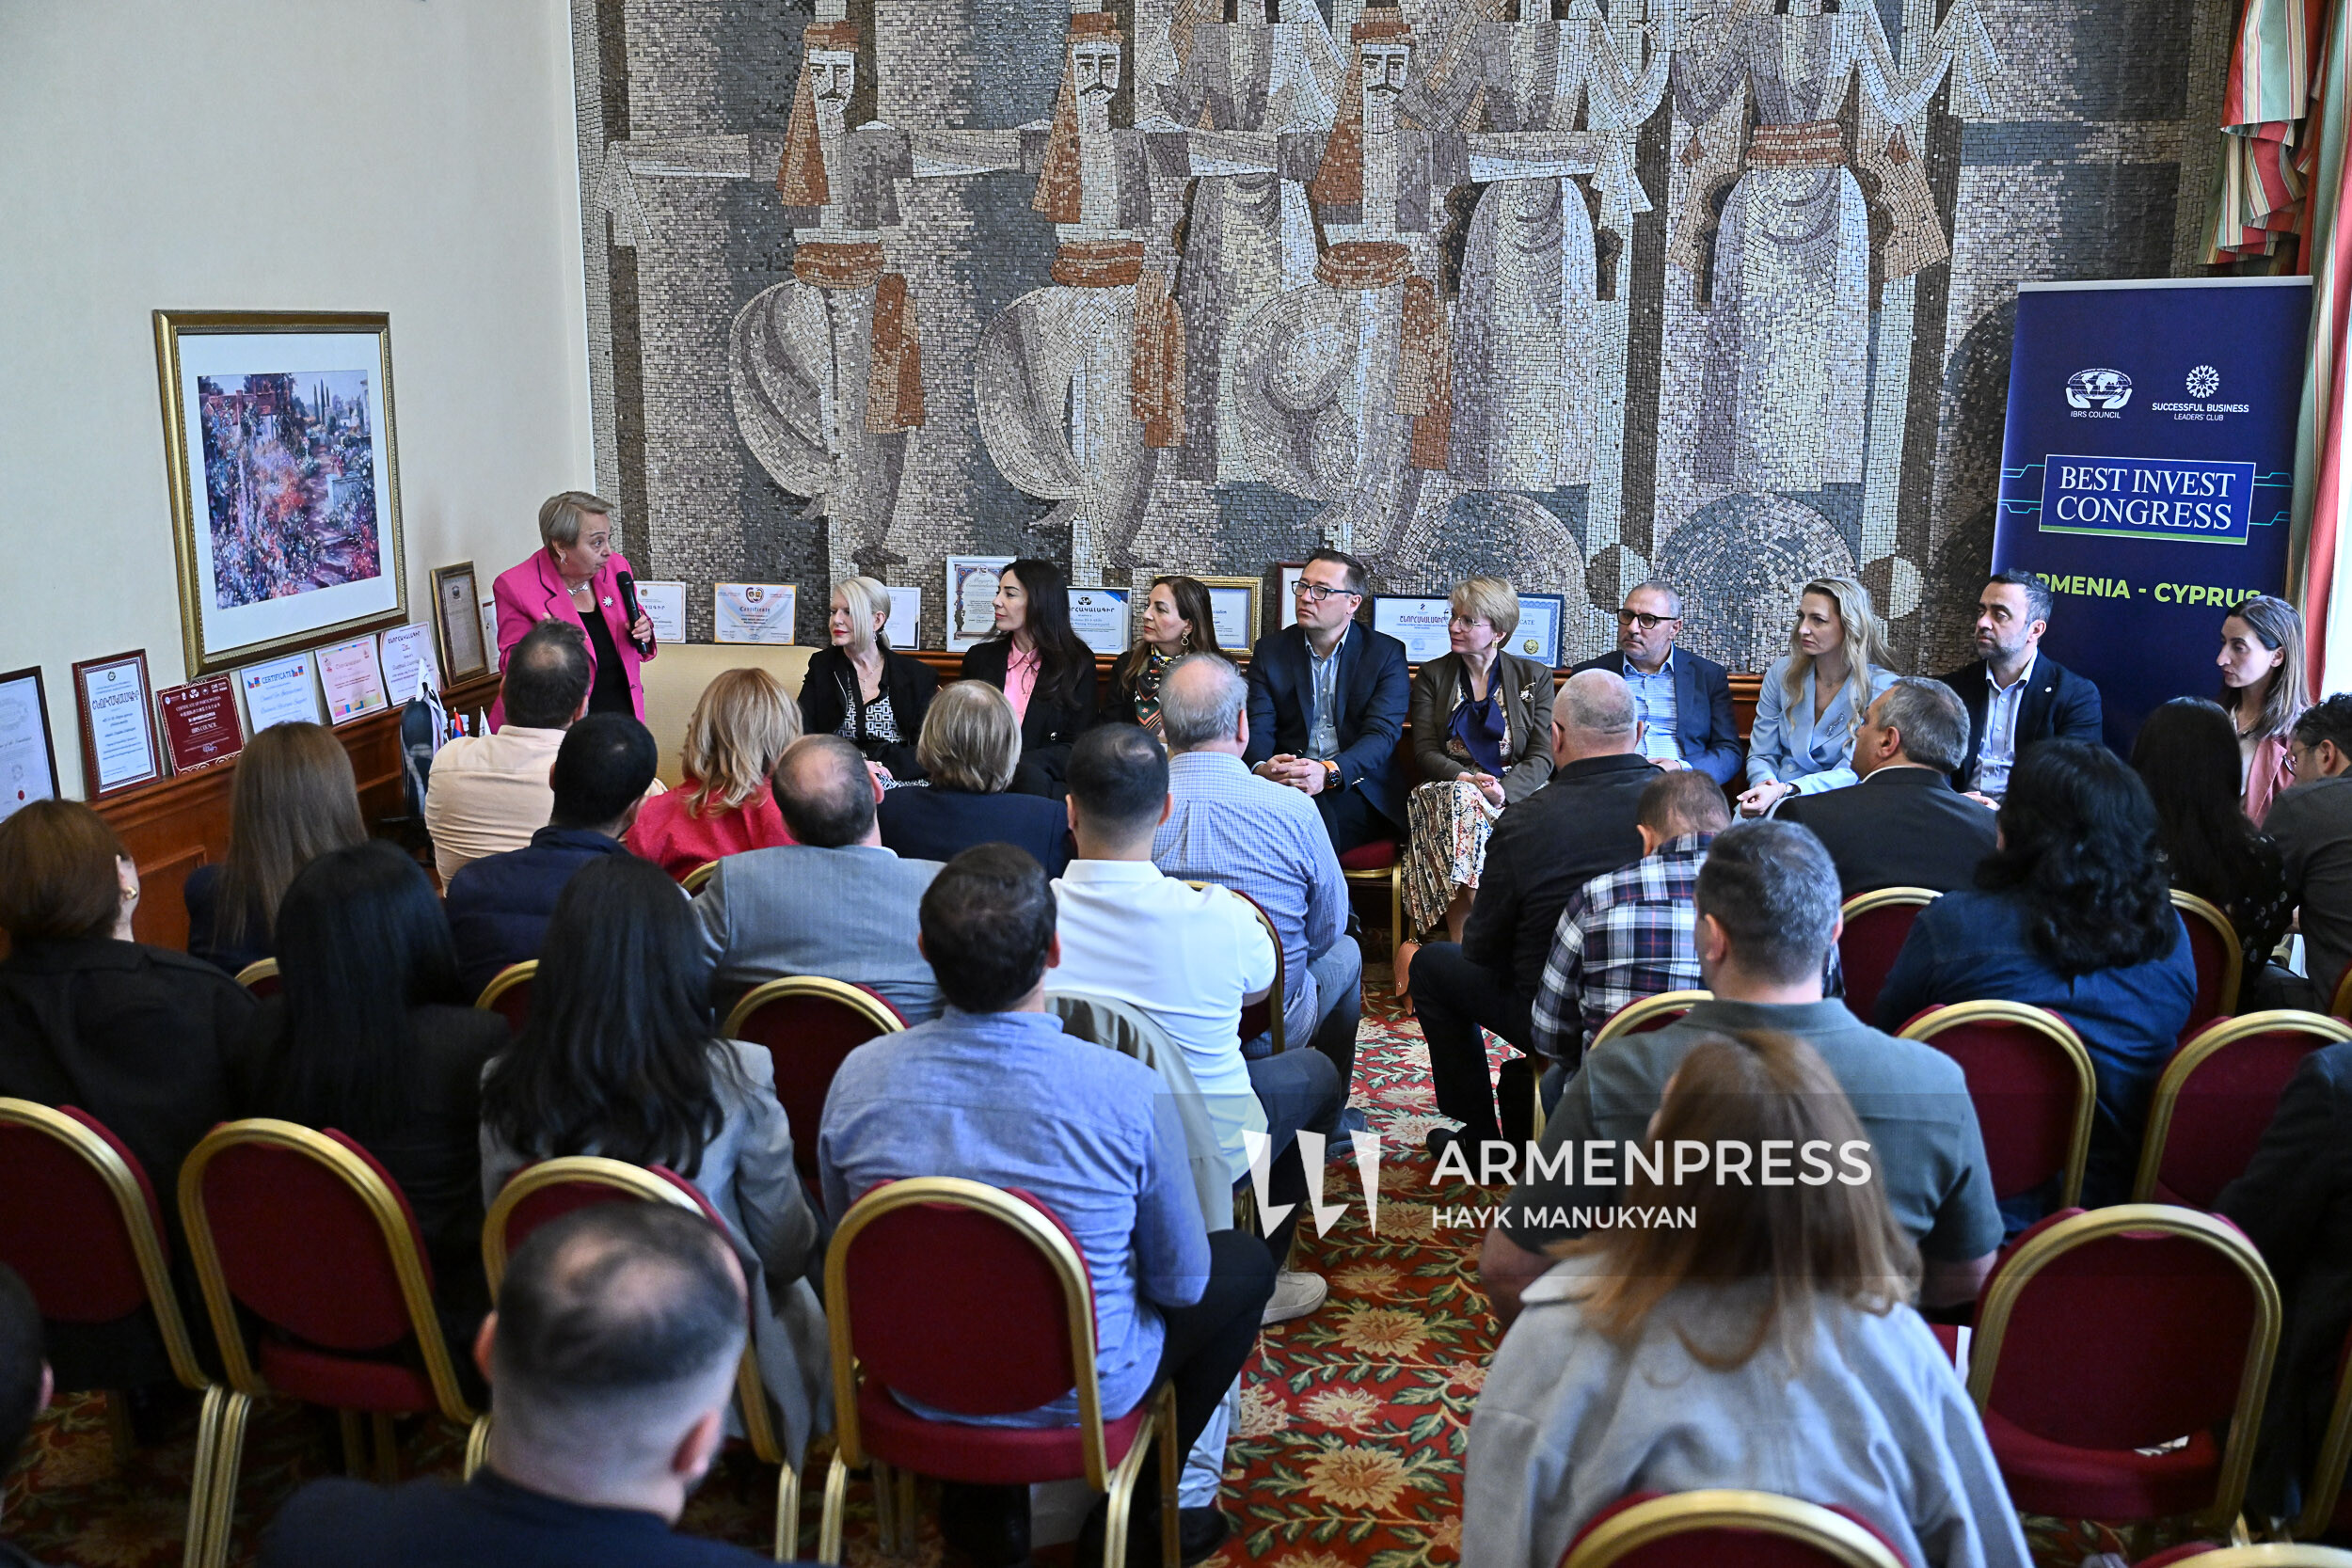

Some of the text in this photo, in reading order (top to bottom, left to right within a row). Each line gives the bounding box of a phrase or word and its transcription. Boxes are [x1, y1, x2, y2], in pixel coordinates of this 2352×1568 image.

[2071, 410, 2121, 420] IBRS COUNCIL
[2152, 403, 2249, 413] SUCCESSFUL BUSINESS
[2058, 466, 2236, 498] BEST INVEST
[2057, 495, 2232, 530] CONGRESS
[2036, 573, 2131, 599] MENIA
[261, 671, 292, 685] CERTIFICATE
